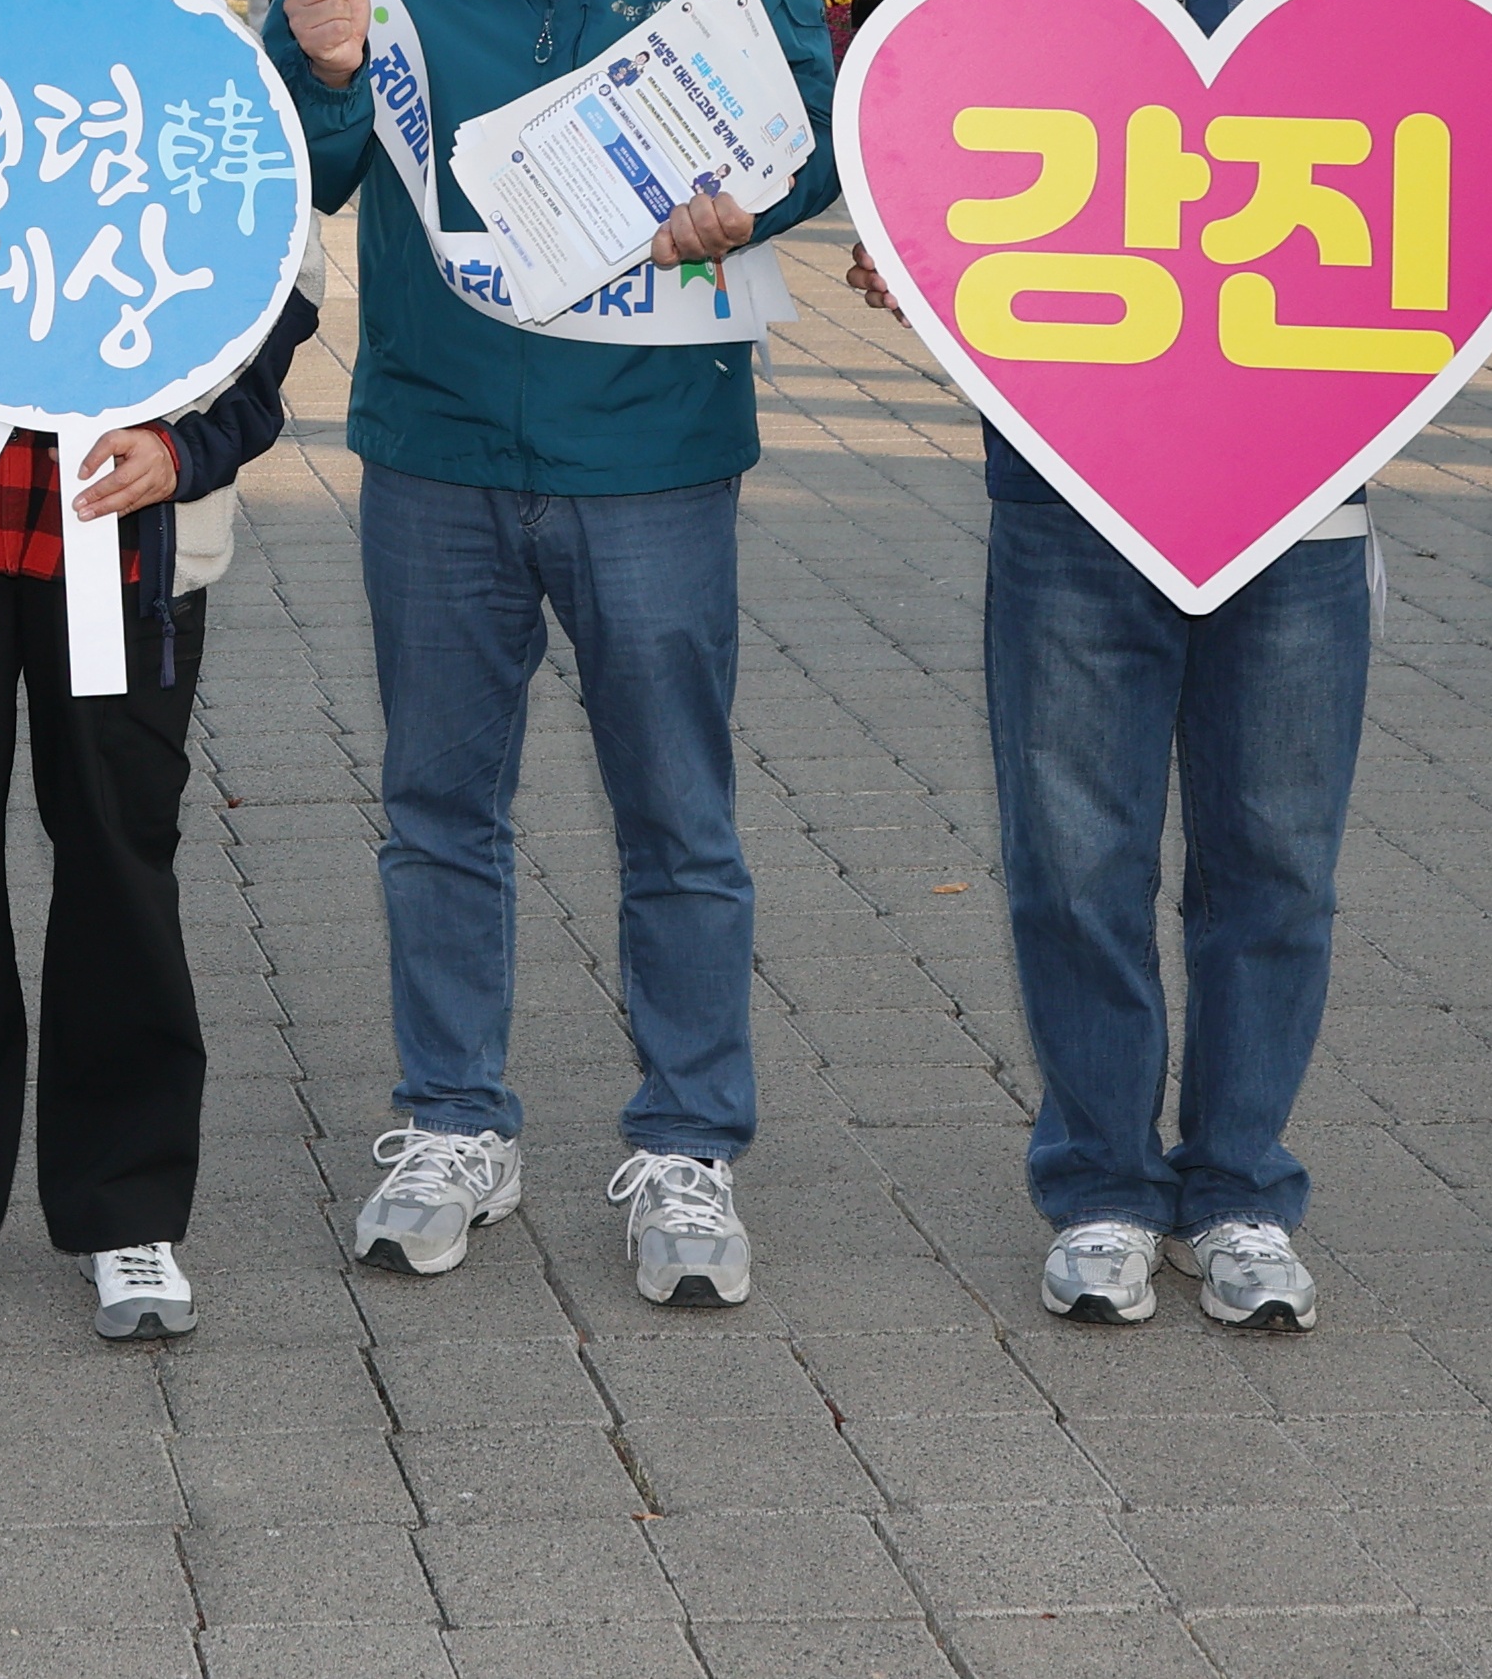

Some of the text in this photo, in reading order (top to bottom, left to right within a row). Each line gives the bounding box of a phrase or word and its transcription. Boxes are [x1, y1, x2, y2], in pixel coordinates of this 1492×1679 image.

[369, 42, 430, 188] 청렴
[645, 29, 679, 68] 비실명
[670, 63, 720, 124] 대리신고와
[711, 117, 739, 149] 함께
[730, 143, 757, 172] 해요
[945, 103, 1456, 376] 강진
